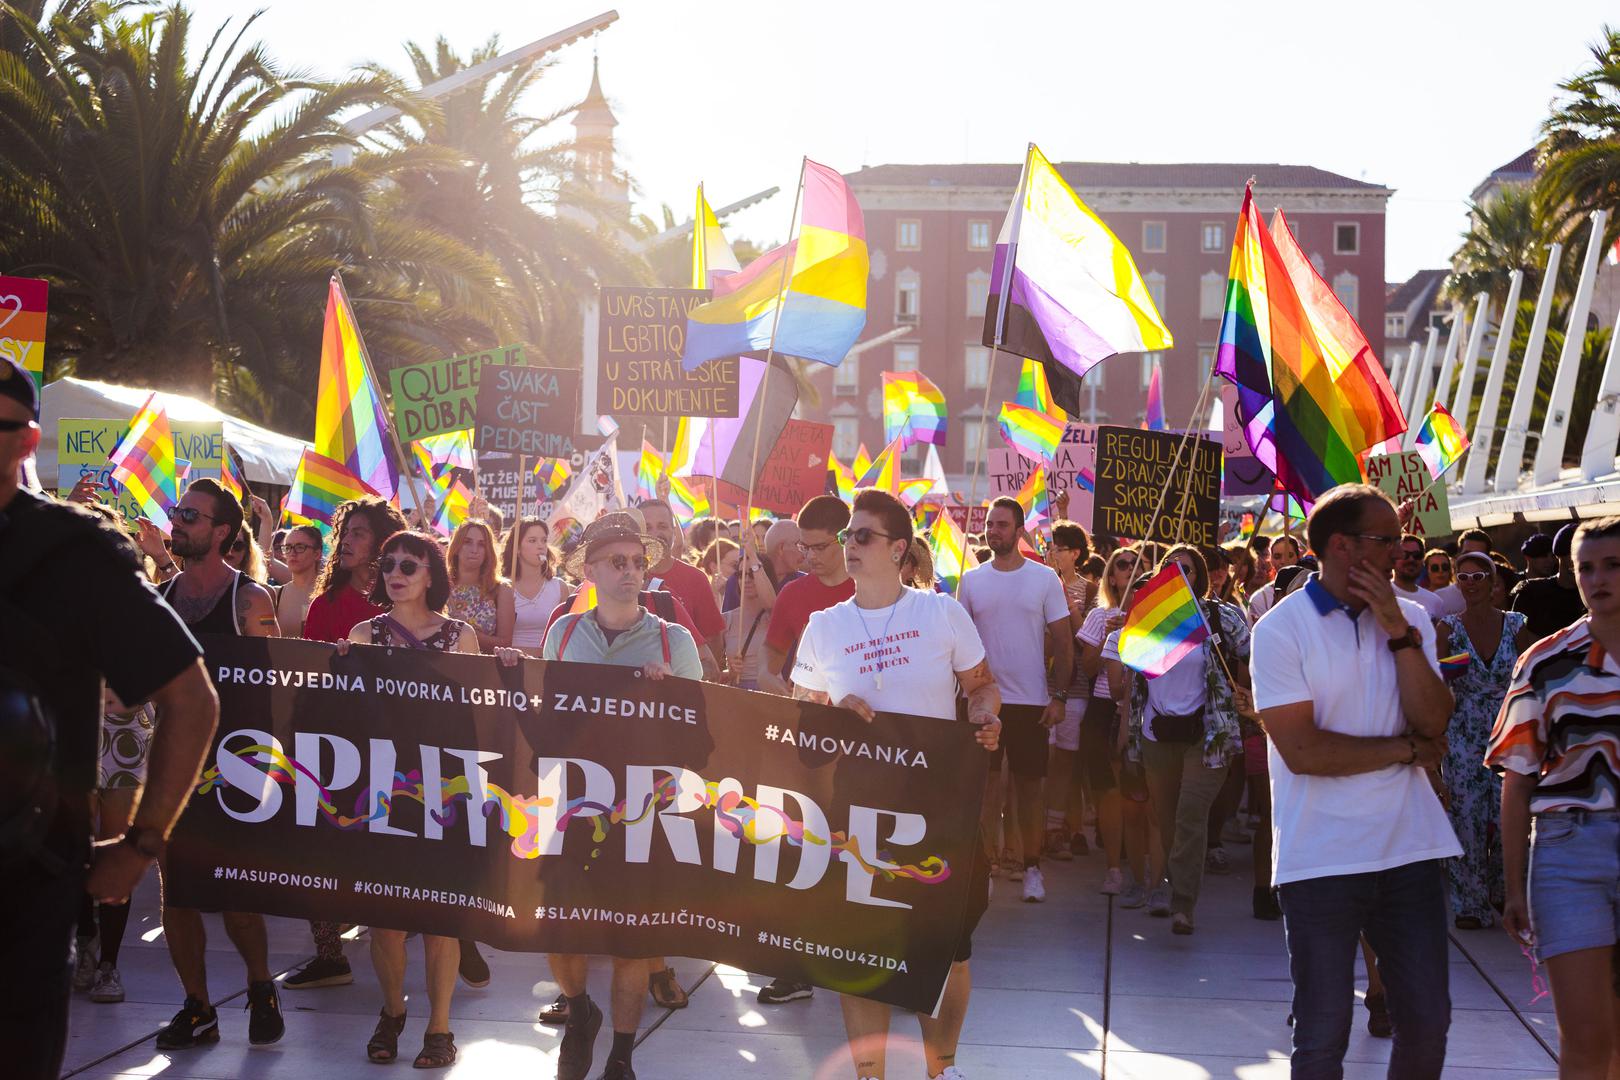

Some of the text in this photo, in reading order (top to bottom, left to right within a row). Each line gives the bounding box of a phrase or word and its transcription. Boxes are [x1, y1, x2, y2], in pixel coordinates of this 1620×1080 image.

[496, 369, 560, 397] SVAKA
[606, 361, 619, 381] U
[496, 394, 549, 425] ČAST
[613, 386, 729, 413] DOKUMENTE
[404, 394, 478, 437] DOBA
[172, 431, 223, 460] TVRDE
[480, 424, 573, 458] PEDERIMA
[1061, 424, 1097, 444] ŽELI
[1173, 490, 1198, 517] ZA
[1100, 505, 1154, 538] TRANS
[1160, 515, 1216, 549] OSOBE
[844, 630, 920, 655] NIJE ME MATER
[863, 645, 902, 661] RODILA
[858, 664, 873, 674] DA
[218, 666, 697, 725] PROSVJEDNA POVORKA LGBTIQ+ ZAJEDNICE
[765, 724, 928, 769] #AMOVANKA
[216, 728, 504, 848] SPLIT
[213, 866, 909, 975] #MASUPONOSNI #KONTRAPREDRASUDAMA #SLAVIMORAZLIČITOSTI #NEĆEMOU4ZIDA
